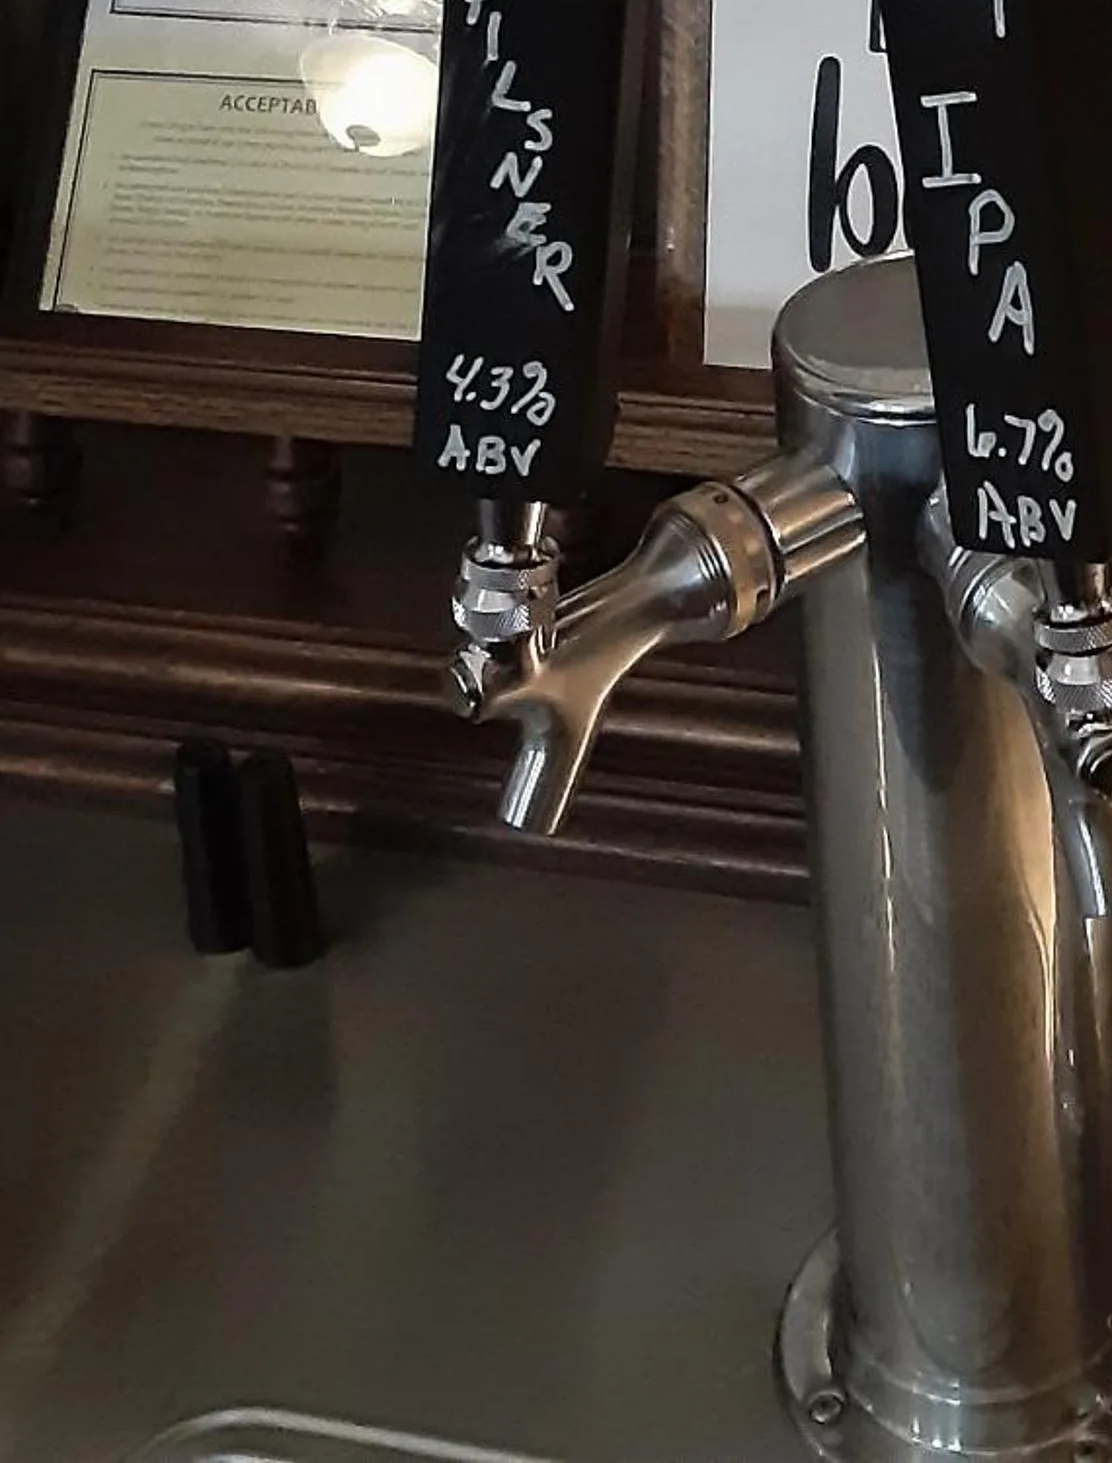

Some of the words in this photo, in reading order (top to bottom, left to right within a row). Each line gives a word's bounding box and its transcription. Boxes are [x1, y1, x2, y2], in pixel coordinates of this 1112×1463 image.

[920, 91, 1034, 355] IPA
[445, 353, 557, 426] 4.3%
[437, 424, 541, 477] ABV
[966, 403, 1075, 483] 6.7%
[977, 481, 1077, 549] ABV
